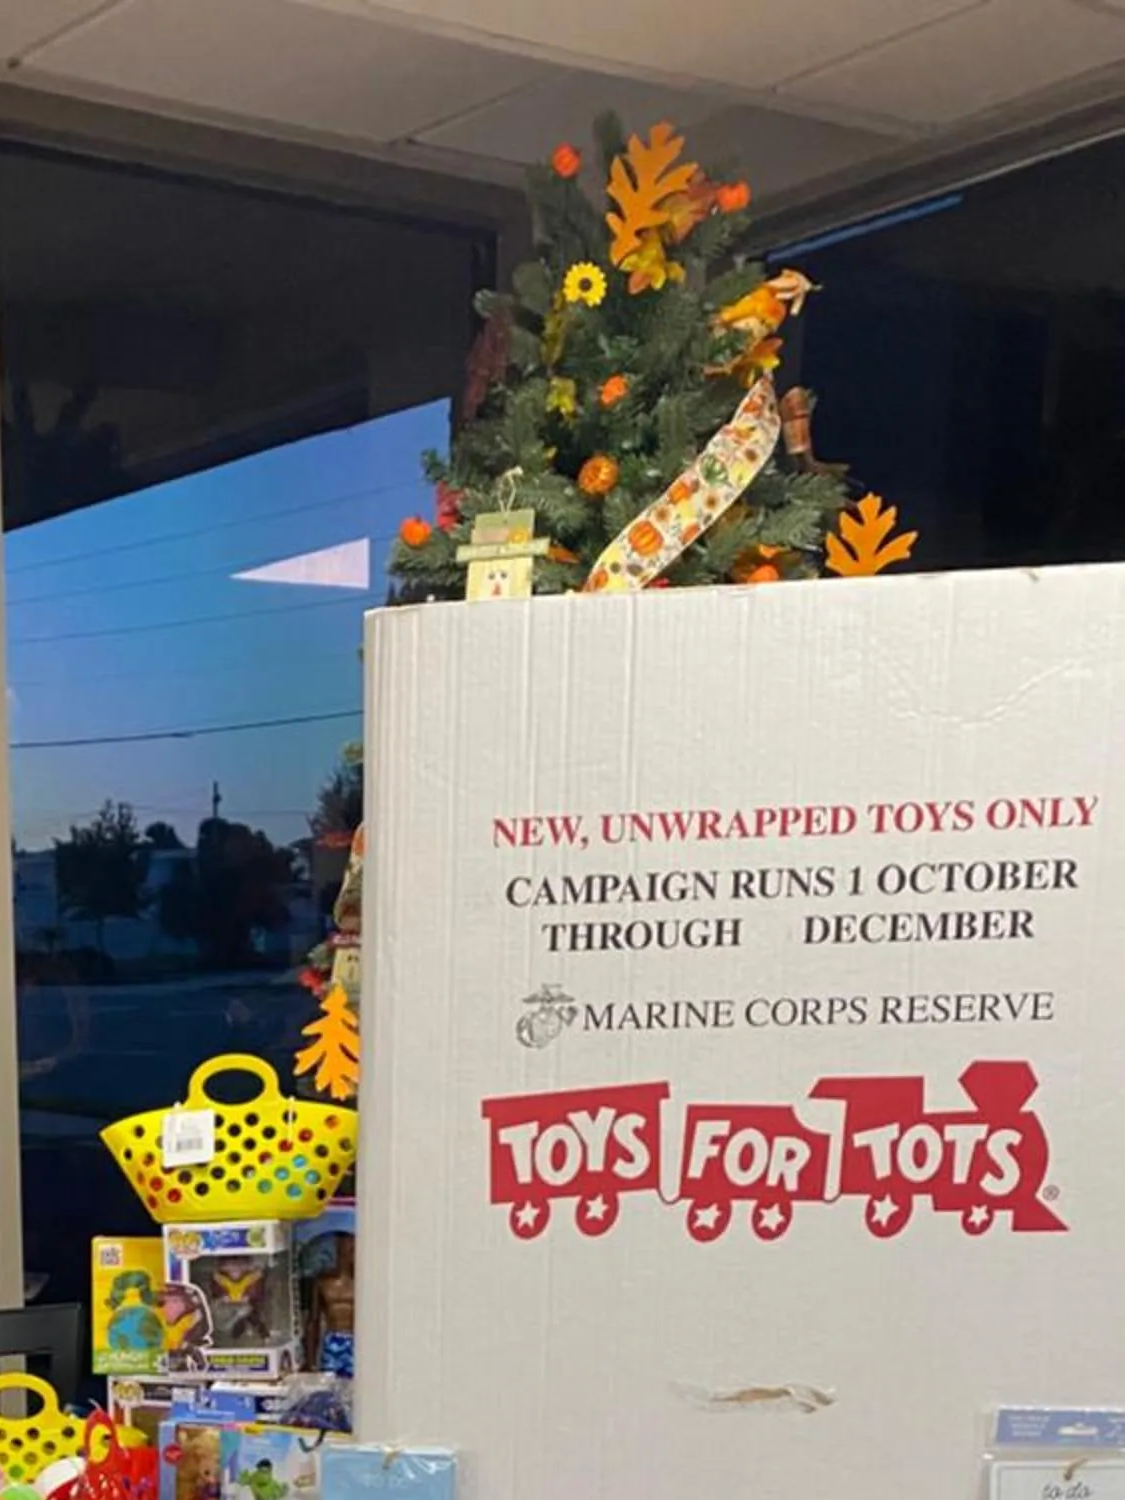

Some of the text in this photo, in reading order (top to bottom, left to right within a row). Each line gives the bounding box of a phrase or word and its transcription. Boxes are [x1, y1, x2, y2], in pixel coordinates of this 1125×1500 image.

[492, 795, 1099, 850] NEW, UNWRAPPED TOYS ONLY
[505, 858, 1080, 908] CAMPAIGN RUNS 1 OCTOBER
[541, 909, 1036, 953] THROUGH DECEMBER
[583, 991, 1055, 1032] MARINE CORPS RESERVE
[497, 1105, 1024, 1198] TOYS FOR TOTS
